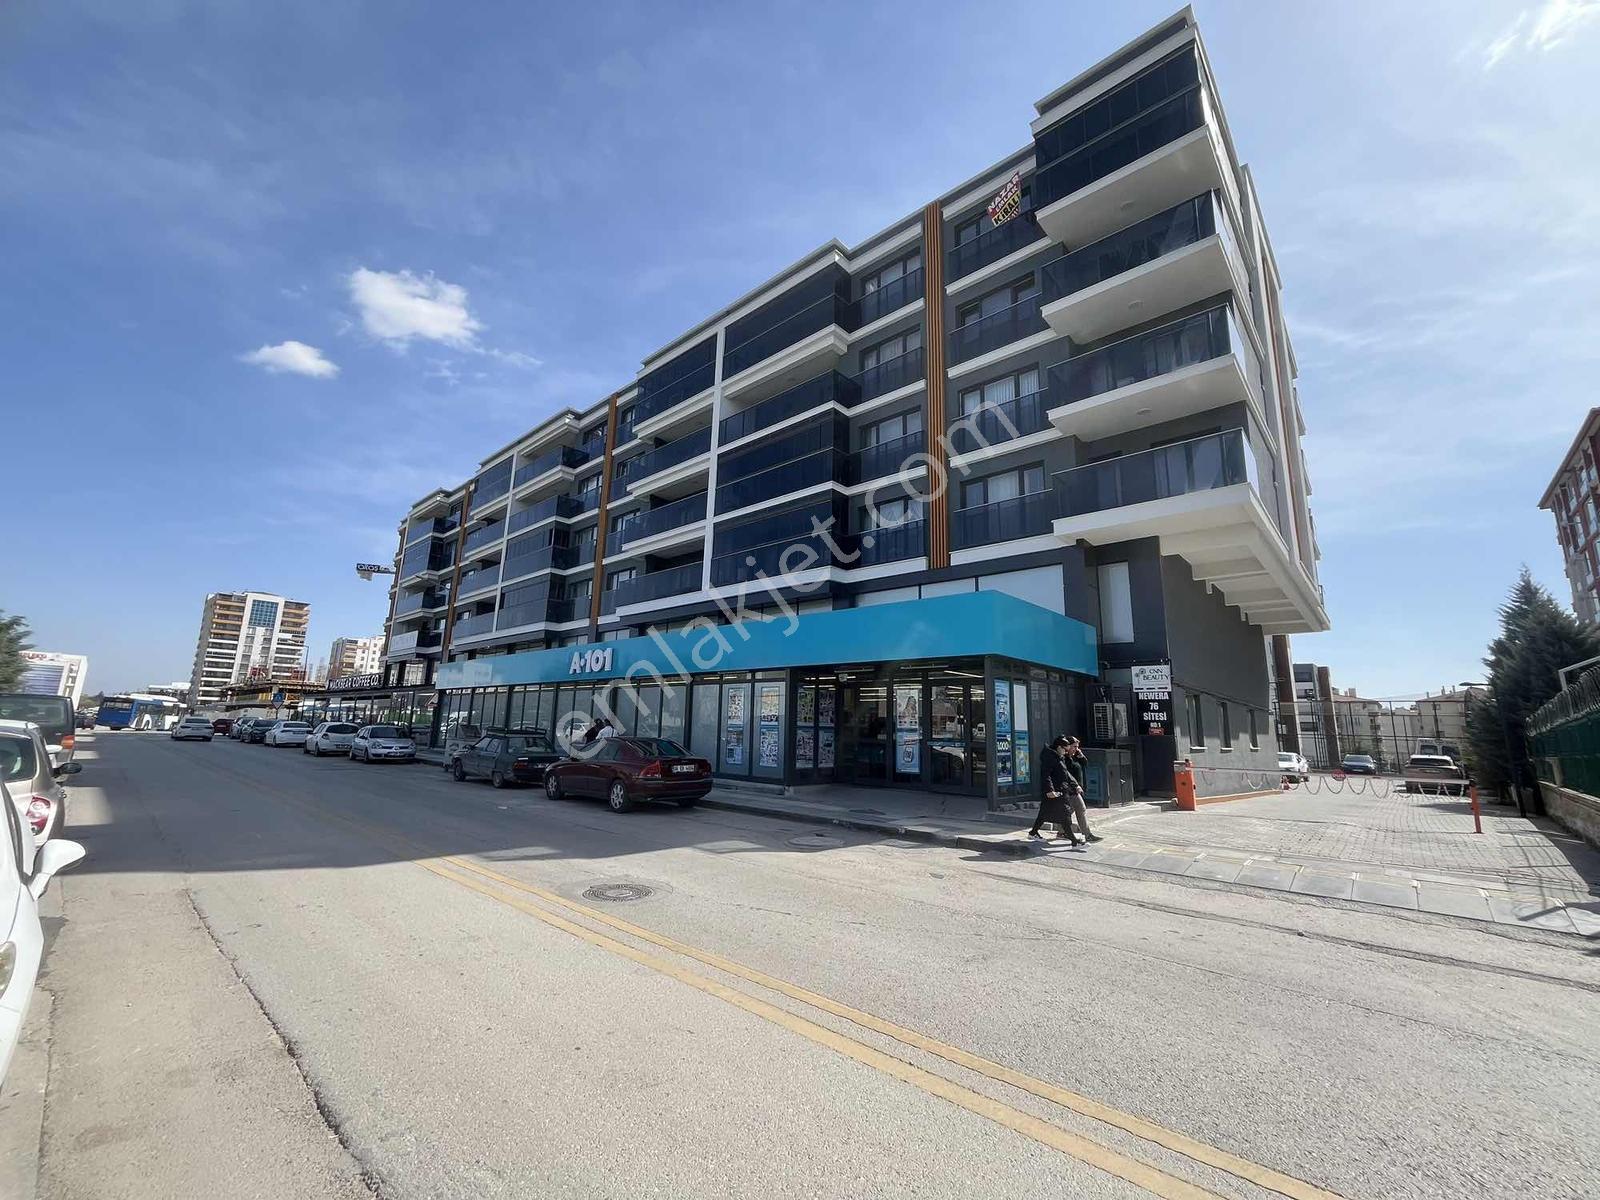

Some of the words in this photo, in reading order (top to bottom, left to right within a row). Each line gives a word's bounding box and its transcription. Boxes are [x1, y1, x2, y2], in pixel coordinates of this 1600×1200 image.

[353, 676, 370, 687] COFFEE
[1138, 692, 1169, 700] NEWERA
[1149, 702, 1159, 710] 76
[1143, 712, 1167, 720] SİTESİ
